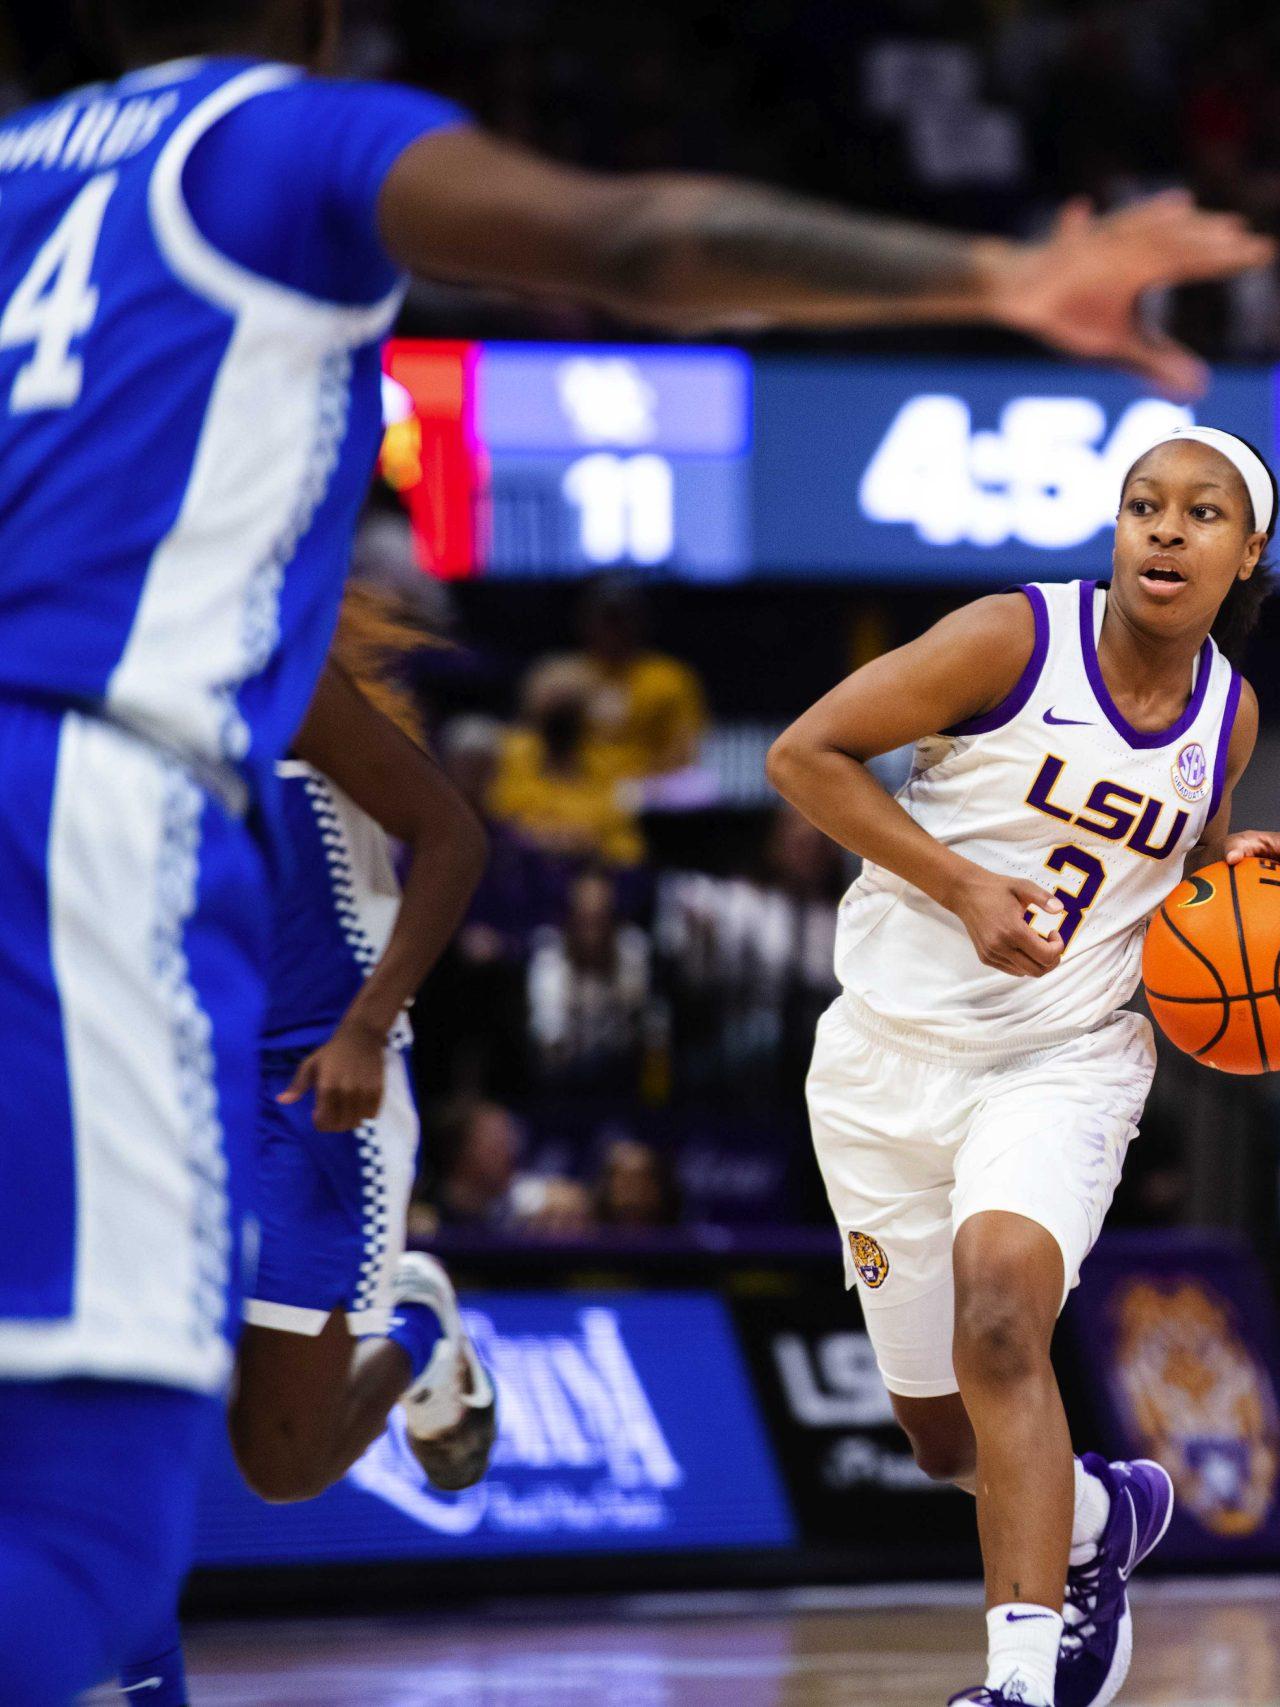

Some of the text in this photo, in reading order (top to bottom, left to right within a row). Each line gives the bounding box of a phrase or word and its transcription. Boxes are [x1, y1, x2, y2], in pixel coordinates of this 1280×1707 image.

[563, 453, 674, 563] 11
[1024, 752, 1190, 861] LSU
[1174, 775, 1205, 799] GRADUATE
[1023, 842, 1108, 955] 3
[773, 1331, 898, 1429] LS
